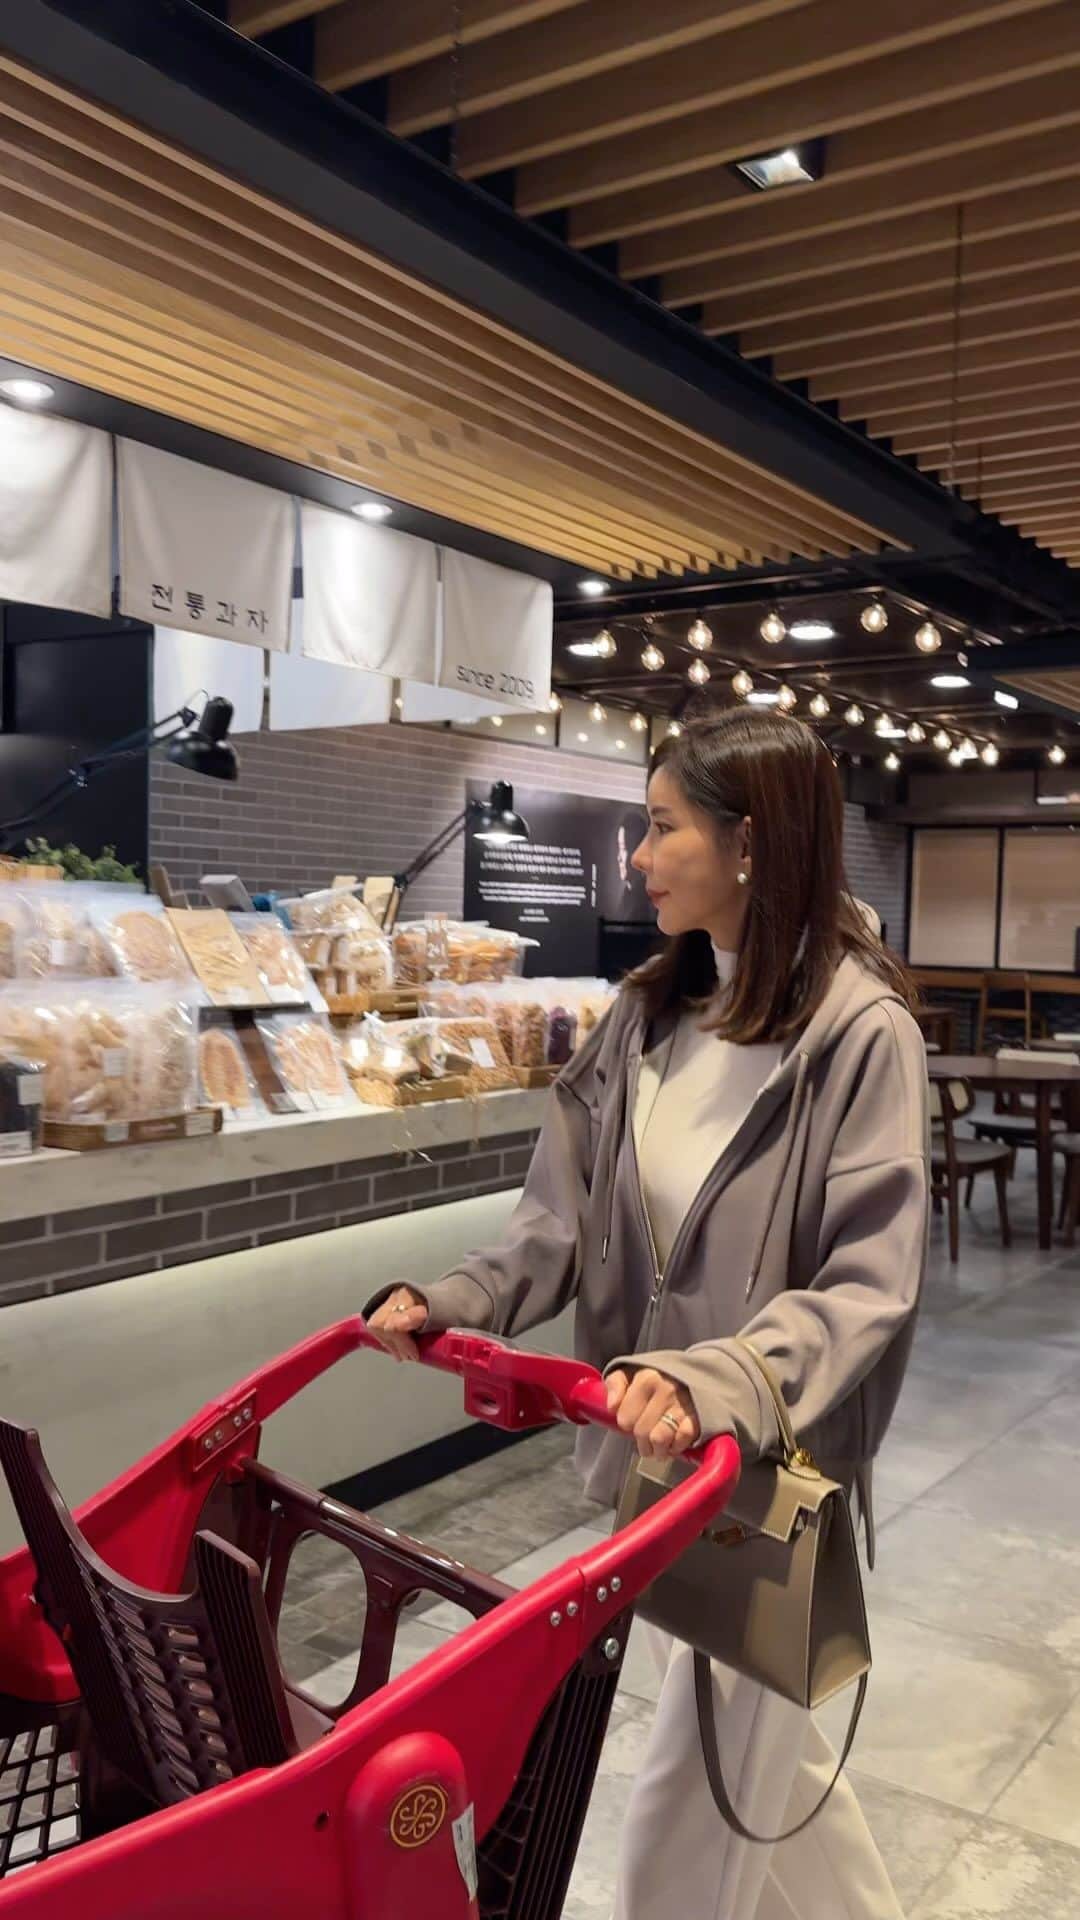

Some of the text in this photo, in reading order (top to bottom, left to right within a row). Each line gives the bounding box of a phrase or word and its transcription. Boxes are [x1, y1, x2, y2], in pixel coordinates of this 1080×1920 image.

[151, 583, 269, 633] 전통과자
[456, 664, 534, 699] since 2009
